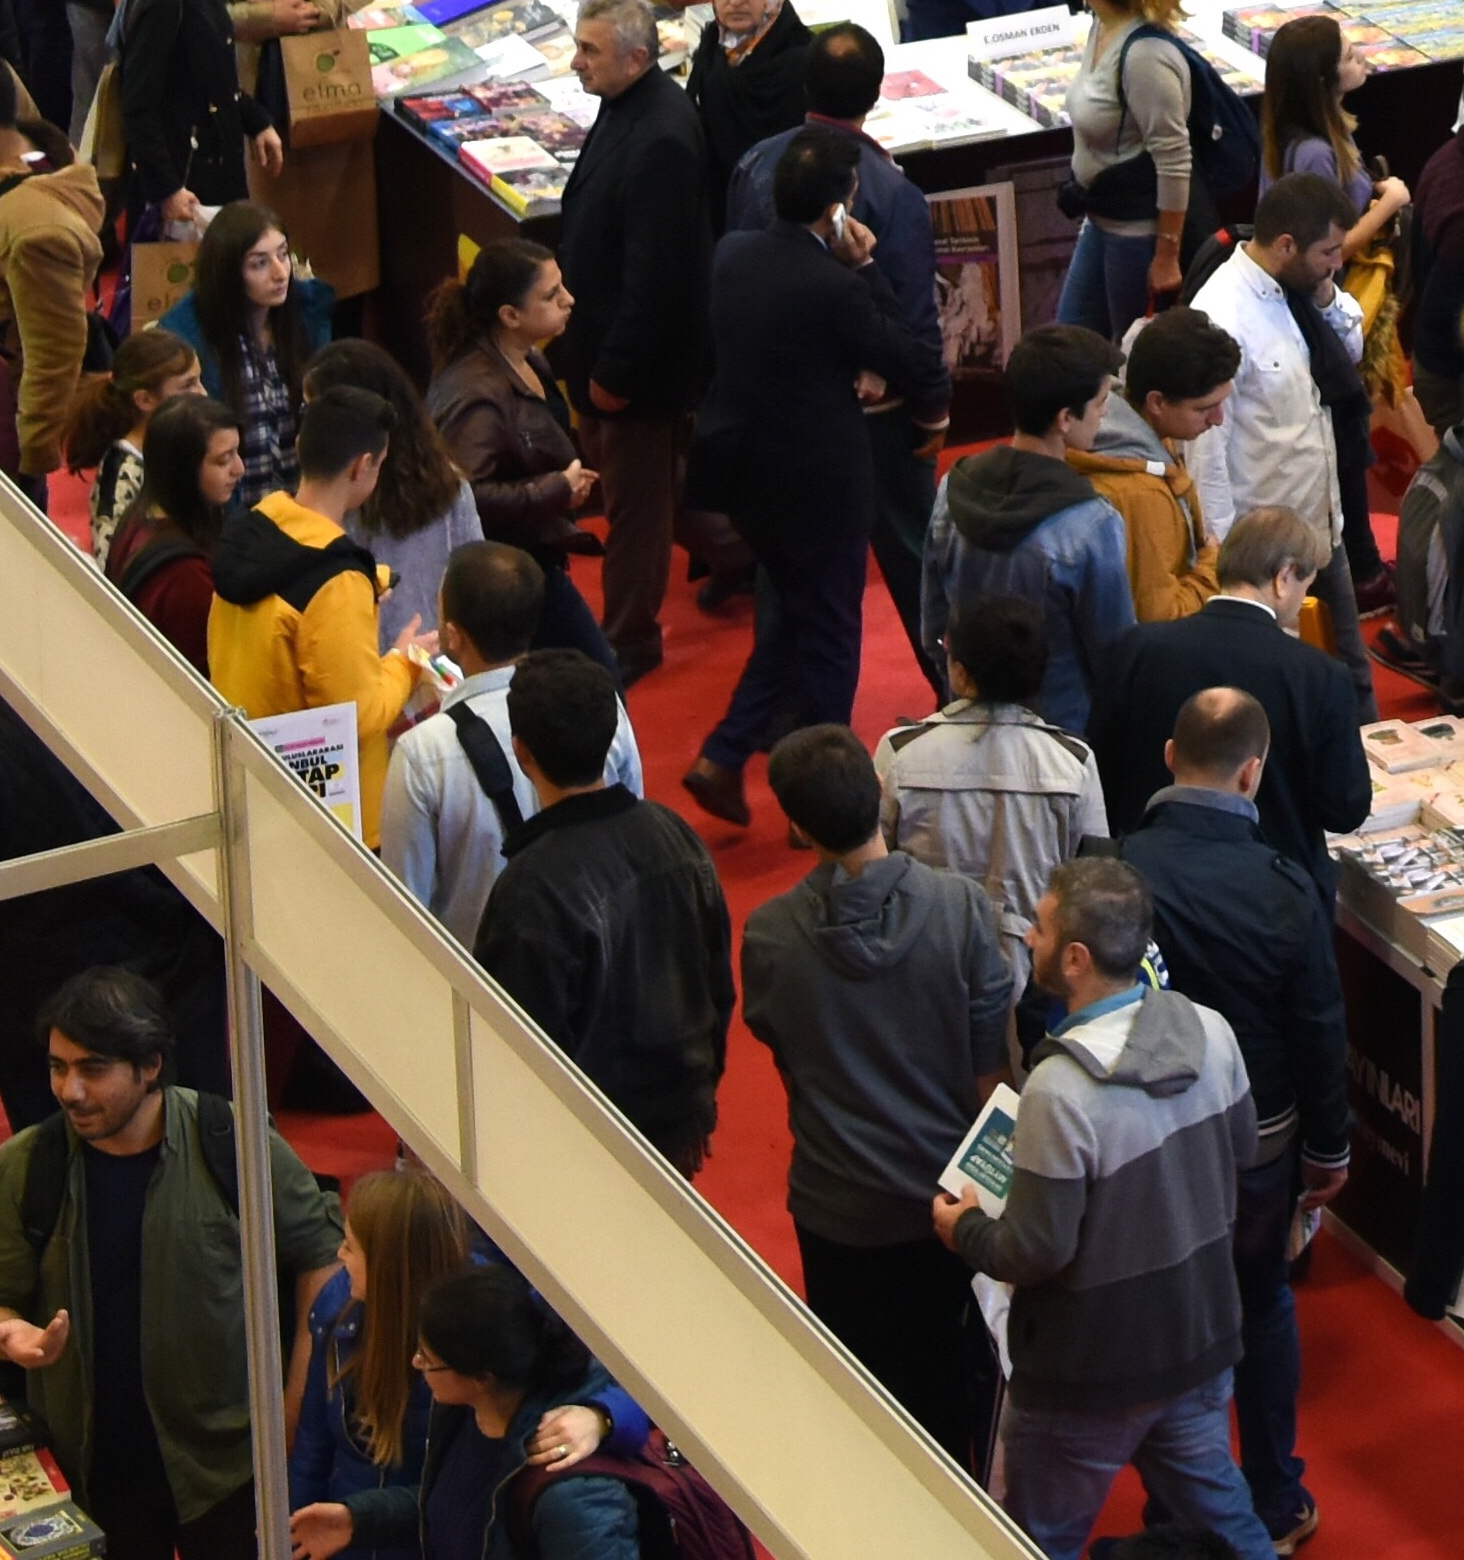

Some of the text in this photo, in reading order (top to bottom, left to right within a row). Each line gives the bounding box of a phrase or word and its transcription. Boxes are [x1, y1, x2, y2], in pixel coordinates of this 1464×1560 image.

[1030, 23, 1060, 36] ERDEN
[302, 80, 362, 101] elma
[298, 764, 339, 783] TAP
[1348, 1046, 1420, 1134] AYINLARI
